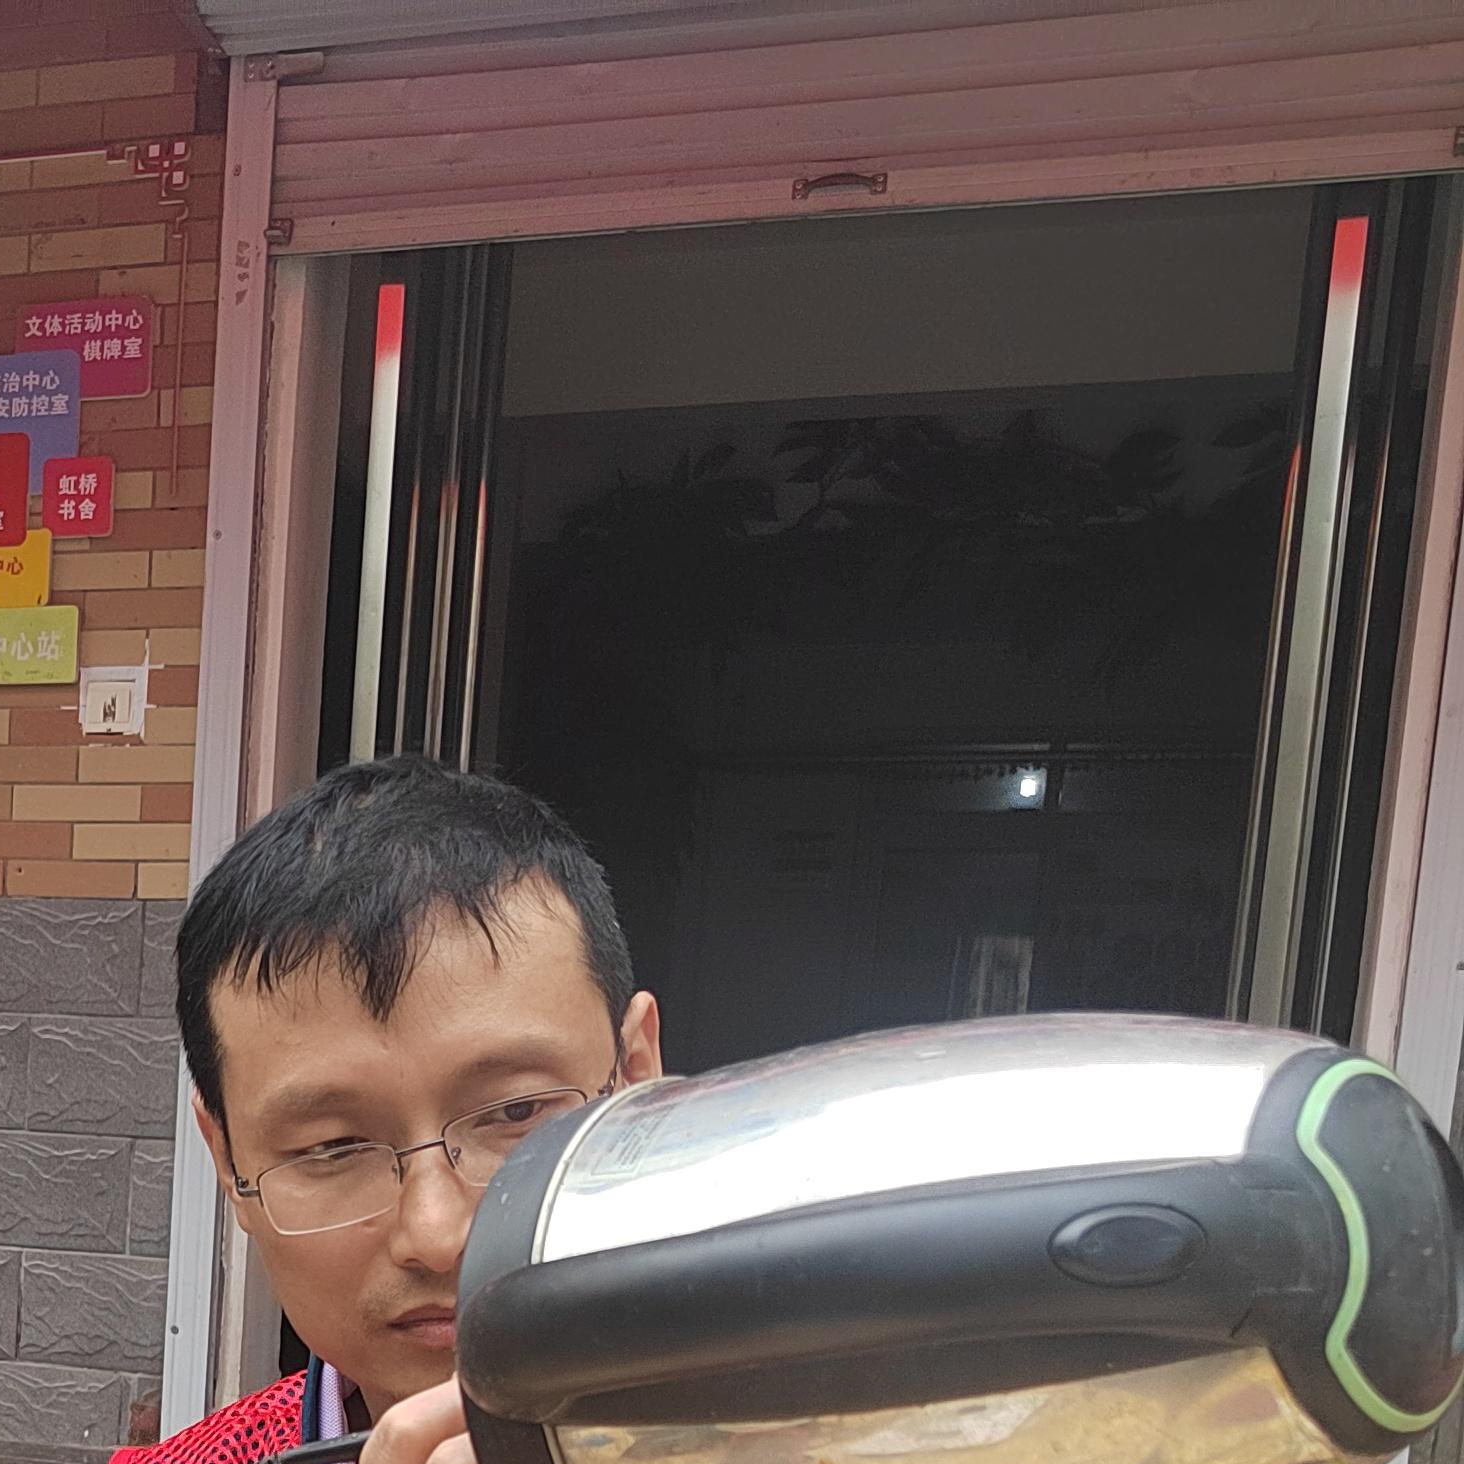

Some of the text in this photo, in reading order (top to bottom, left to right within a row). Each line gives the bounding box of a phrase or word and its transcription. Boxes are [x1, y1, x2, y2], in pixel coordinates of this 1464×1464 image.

[25, 310, 144, 337] 文体活动中心
[83, 337, 143, 361] 棋牌室
[58, 474, 98, 495] 虹桥
[58, 498, 97, 520] 书舍
